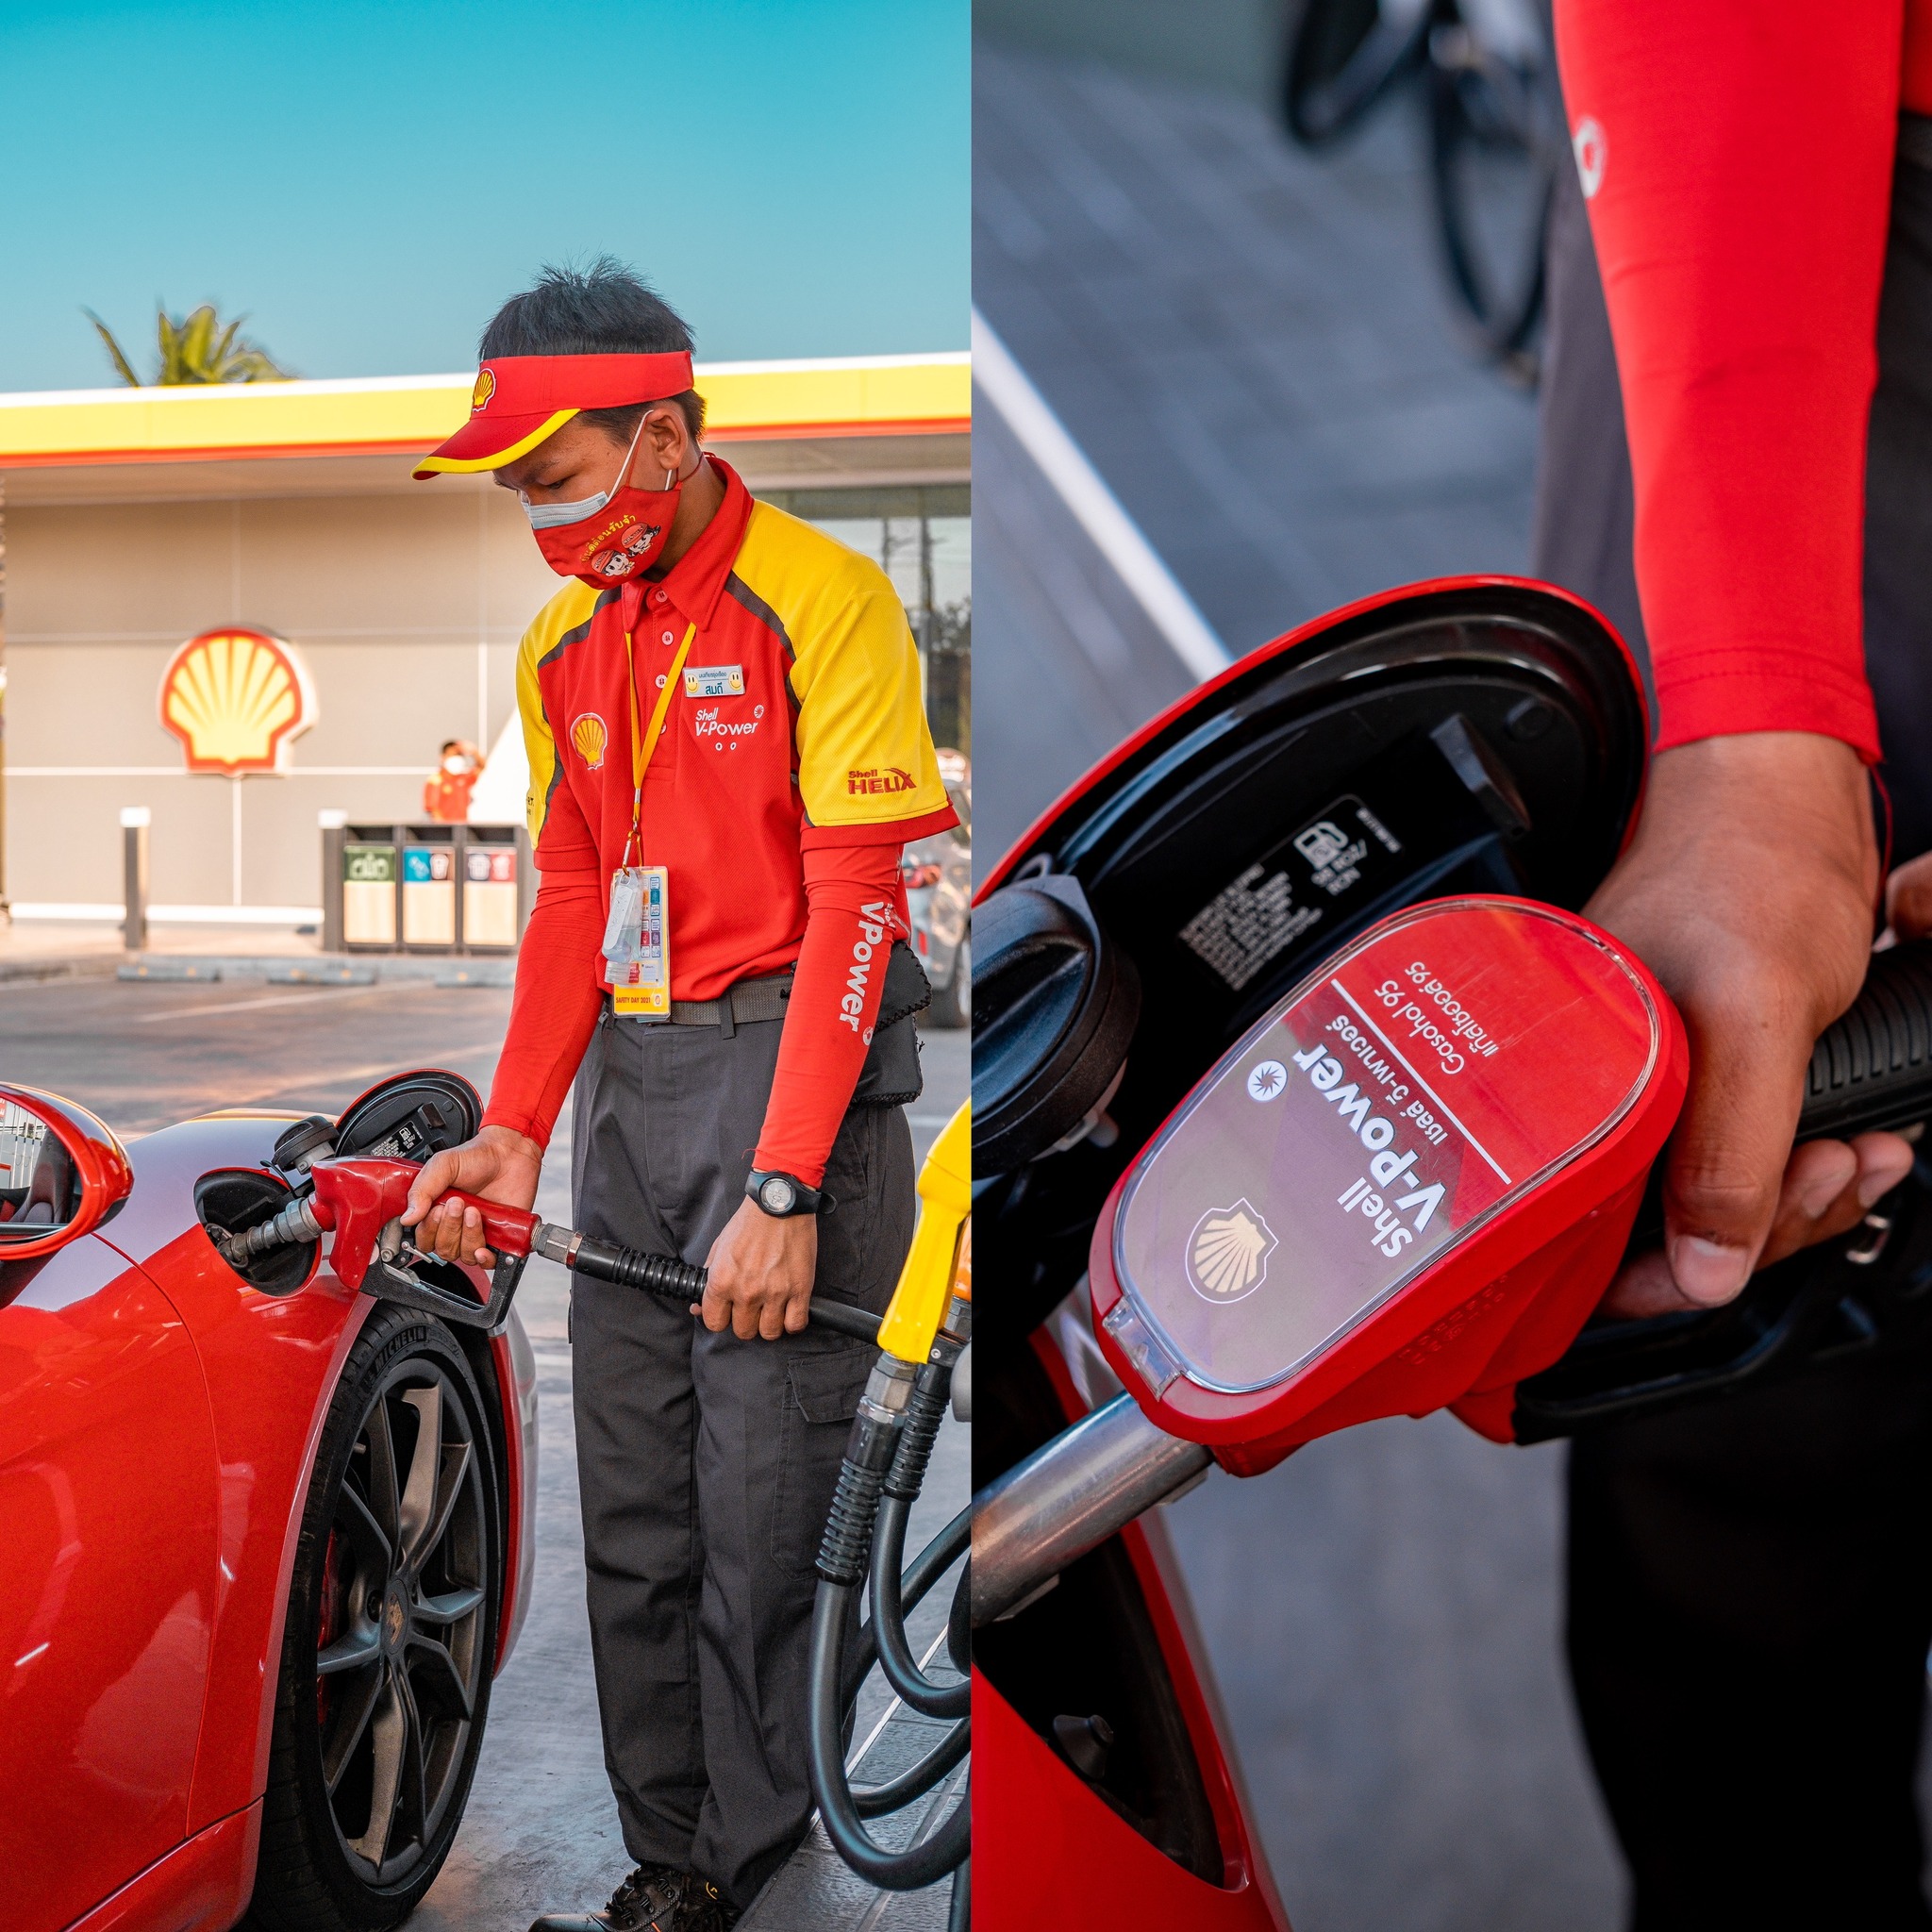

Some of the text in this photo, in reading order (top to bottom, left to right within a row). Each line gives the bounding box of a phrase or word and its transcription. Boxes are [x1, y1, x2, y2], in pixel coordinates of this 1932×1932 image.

[705, 682, 724, 695] สมดี
[695, 707, 719, 721] Shell
[694, 721, 758, 736] V-Power
[847, 767, 917, 794] HELIX
[848, 769, 877, 778] Shell
[1404, 961, 1431, 985] 95
[1374, 979, 1465, 1074] Gasohol 95
[1325, 1014, 1448, 1146] เชลล์ วี-เพาเวอร์
[1291, 1043, 1446, 1235] V-Power
[1337, 1176, 1413, 1257] Shell
[374, 1325, 427, 1374] MICHELIN
